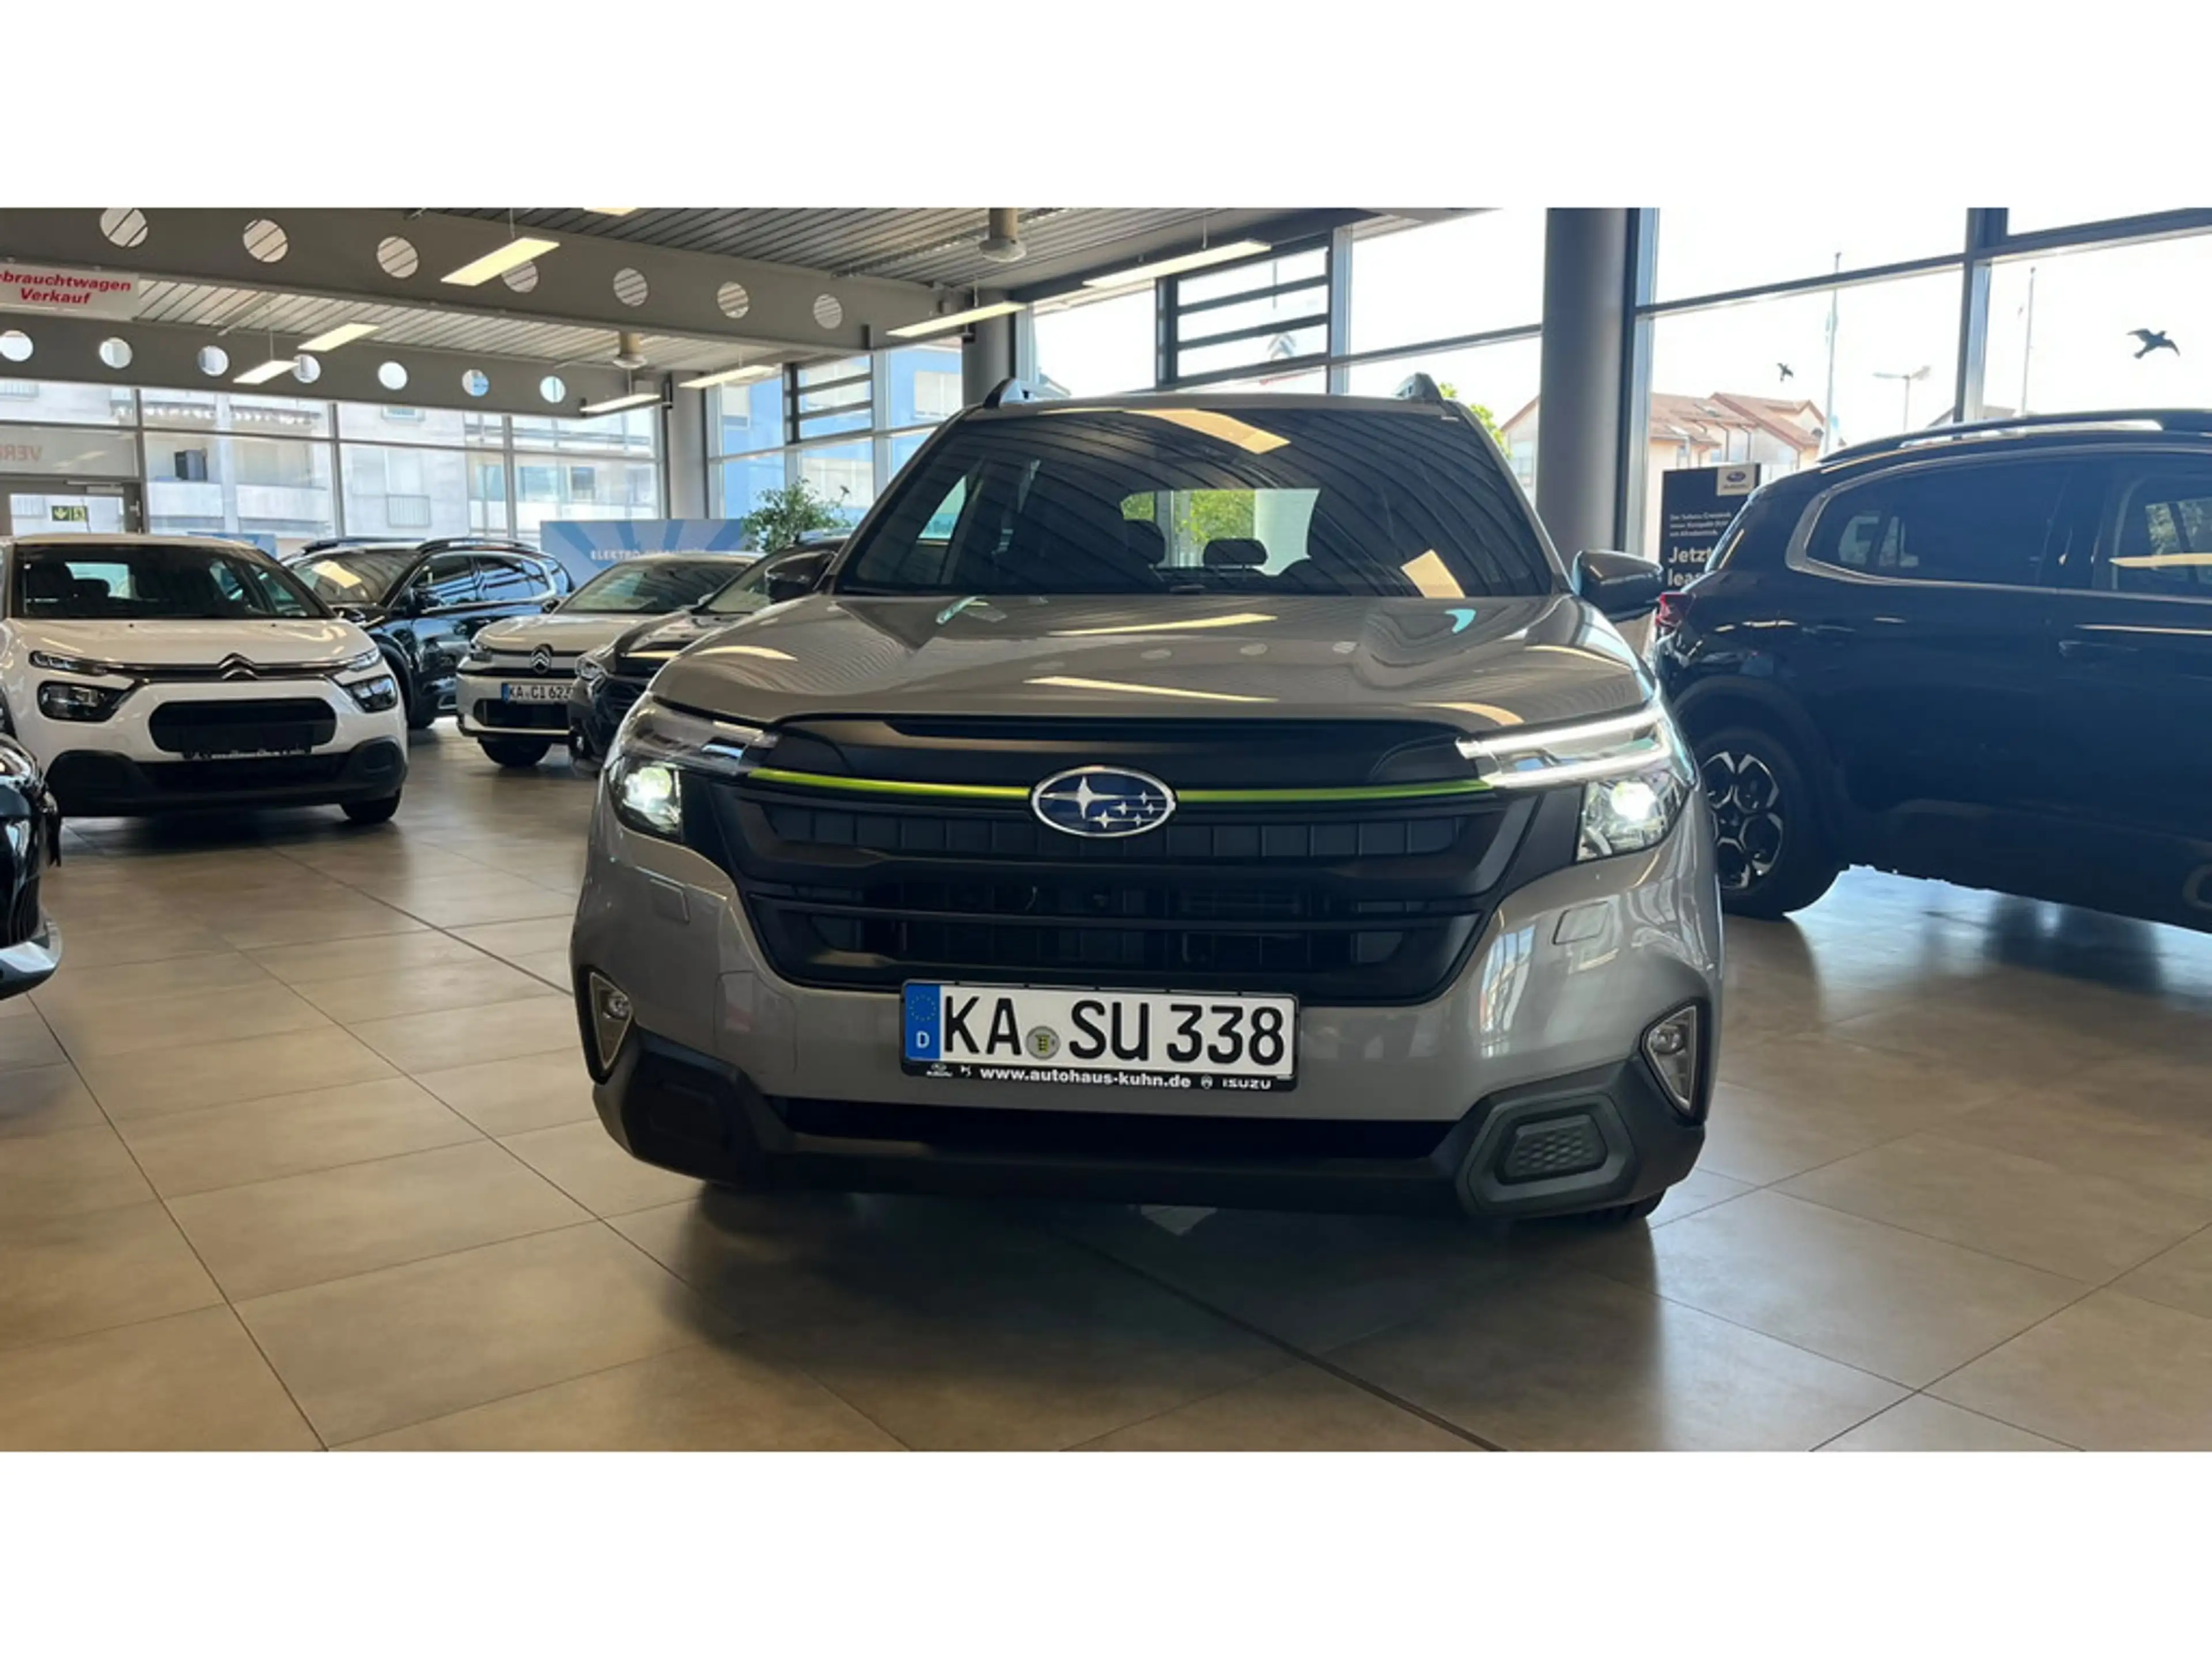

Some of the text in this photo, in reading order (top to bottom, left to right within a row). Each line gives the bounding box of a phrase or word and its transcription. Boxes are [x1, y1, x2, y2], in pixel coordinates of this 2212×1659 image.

[21, 288, 91, 304] Verkauf
[1668, 546, 1713, 563] Jetzt
[944, 995, 1285, 1066] KA SU 338
[916, 1031, 930, 1048] D
[980, 1067, 1191, 1088] www.autohaus-kuhn.de
[1223, 1078, 1271, 1089] ISUZU
